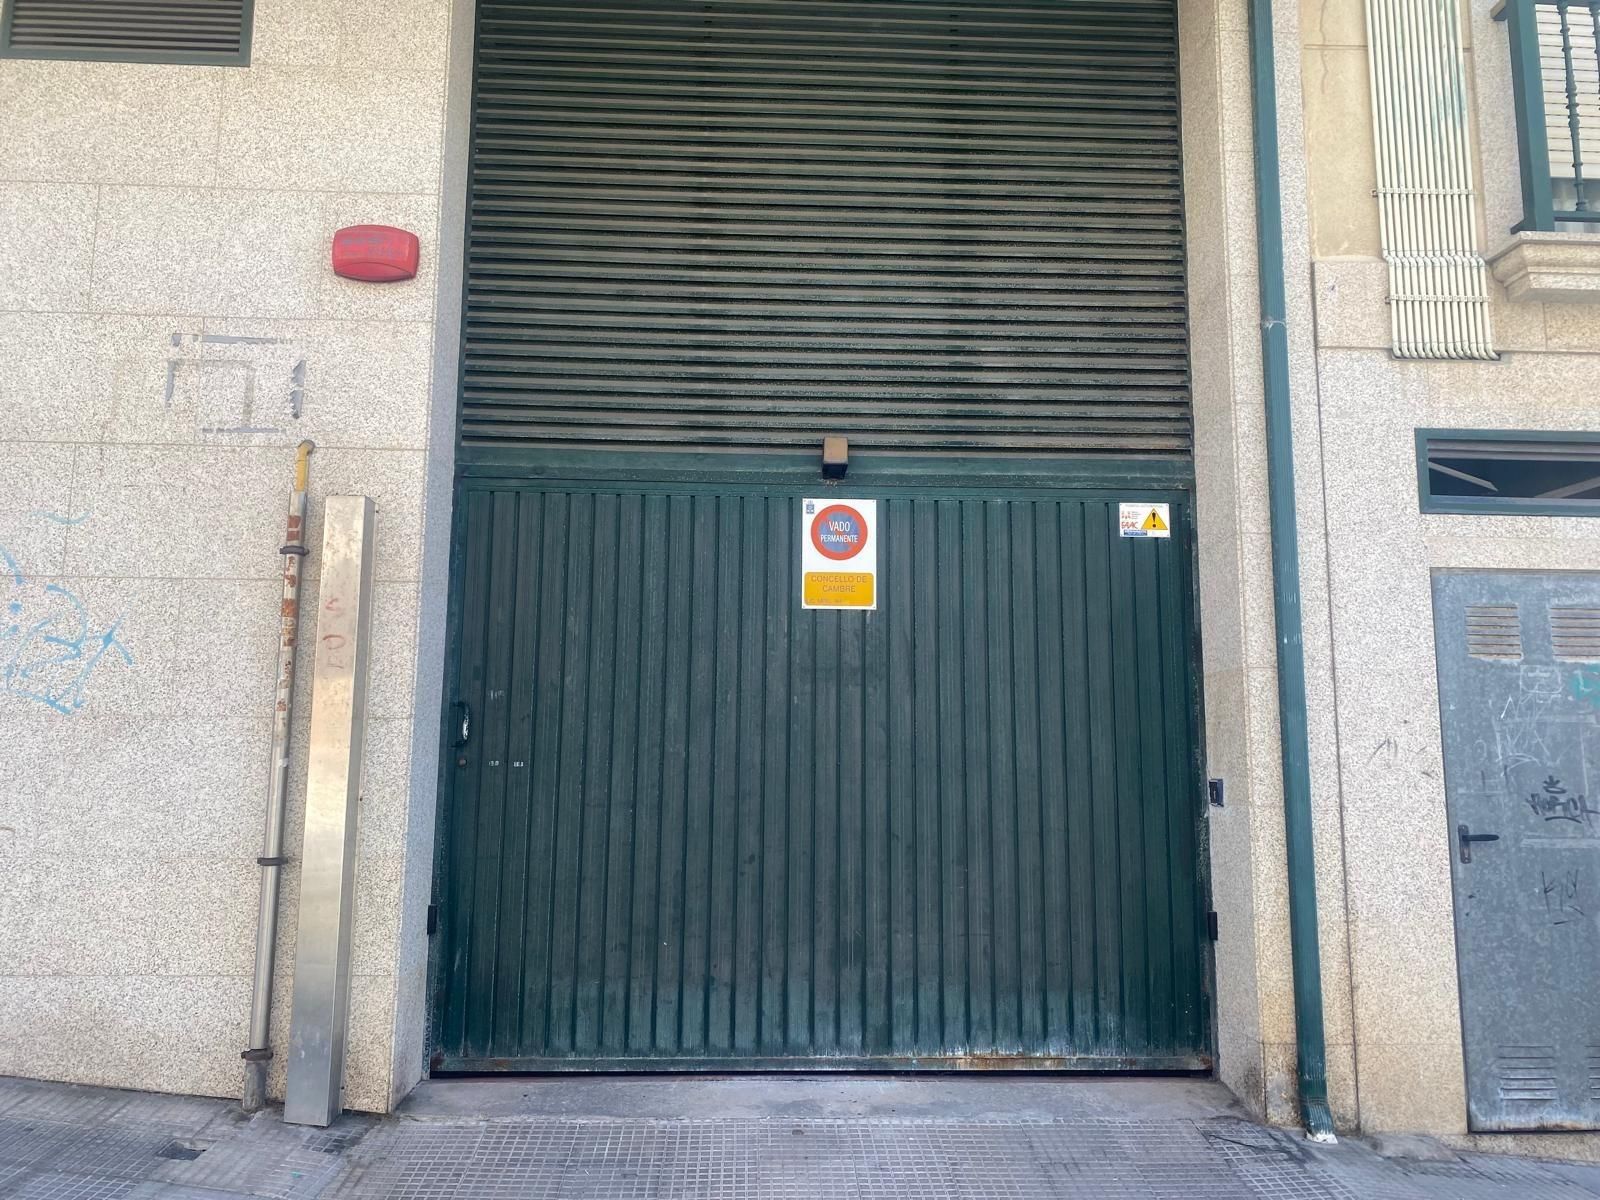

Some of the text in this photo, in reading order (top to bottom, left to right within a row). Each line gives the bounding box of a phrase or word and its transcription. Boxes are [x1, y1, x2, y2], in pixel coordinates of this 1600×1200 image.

[829, 521, 850, 531] VADO
[820, 534, 858, 543] PERMANENTE
[811, 575, 868, 583] CONCELLO DE
[822, 585, 856, 593] CAMBRE
